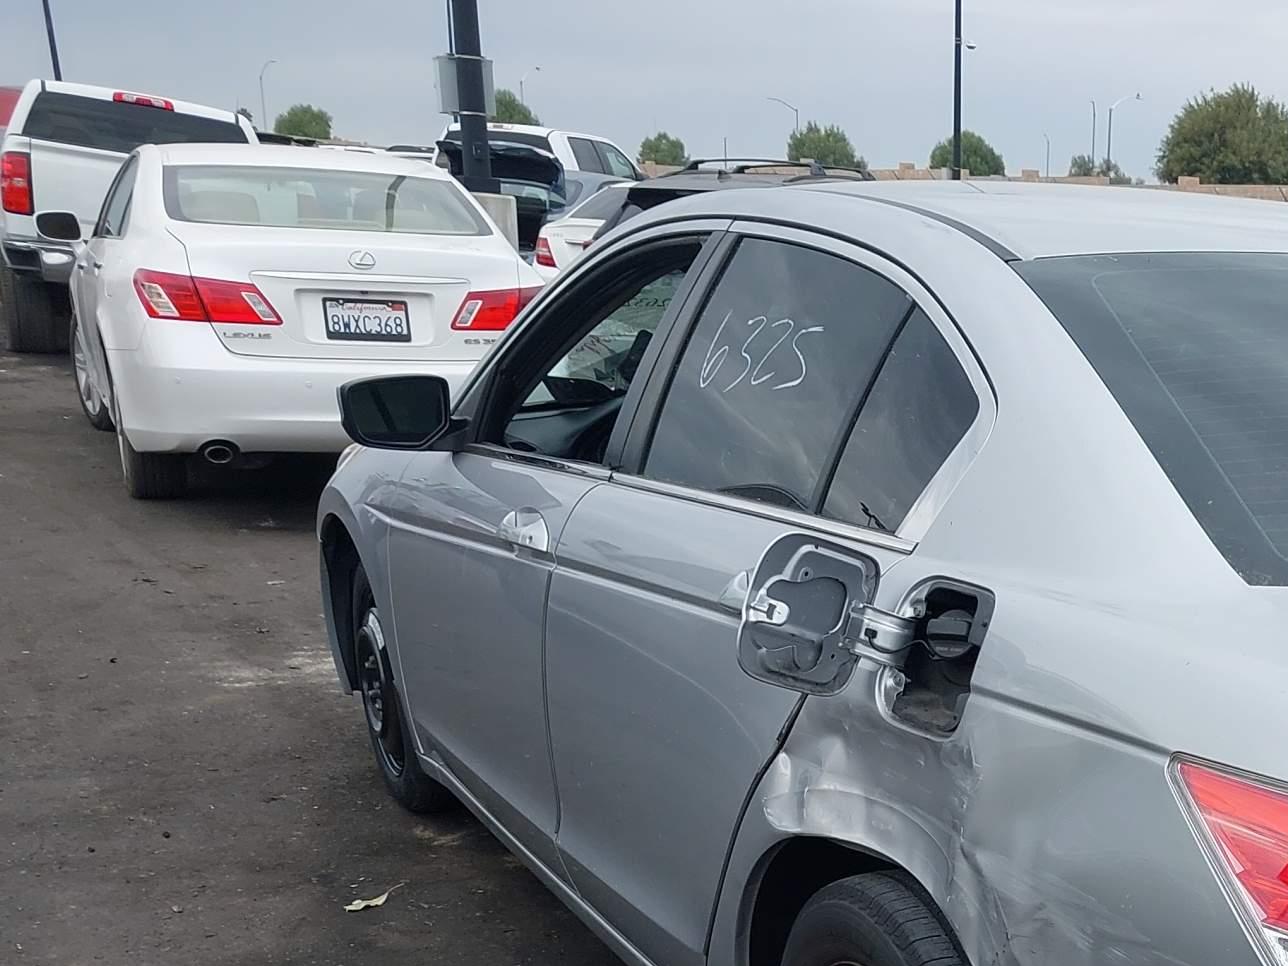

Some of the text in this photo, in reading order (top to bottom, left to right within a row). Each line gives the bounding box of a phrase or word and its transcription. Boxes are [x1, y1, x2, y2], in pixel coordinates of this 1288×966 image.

[331, 314, 405, 335] 8WXC368
[222, 331, 273, 341] LEXUS
[700, 308, 825, 393] 6325
